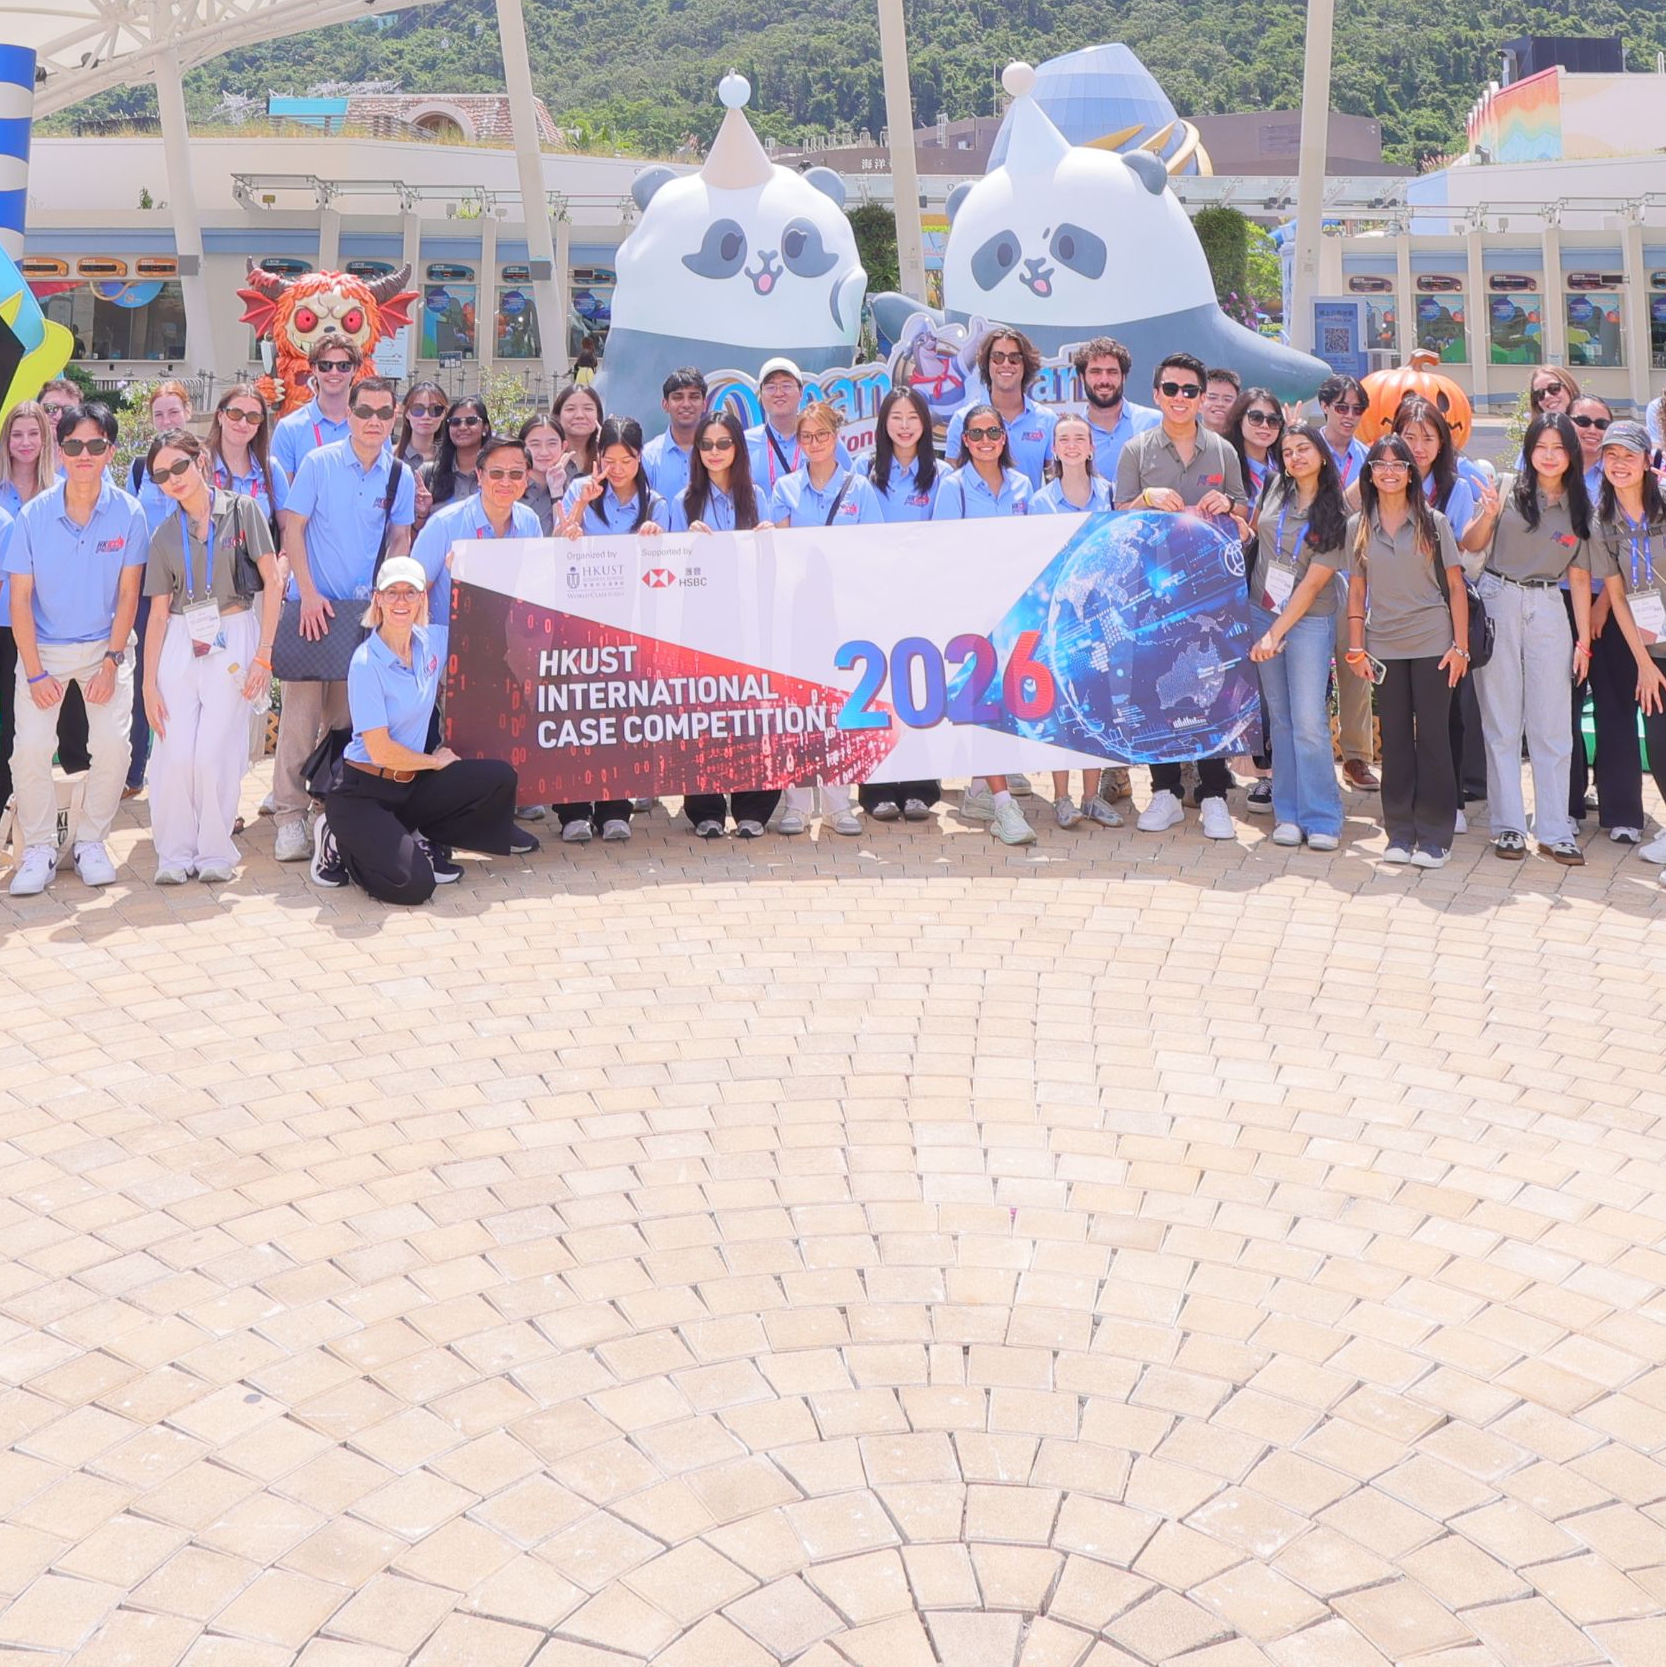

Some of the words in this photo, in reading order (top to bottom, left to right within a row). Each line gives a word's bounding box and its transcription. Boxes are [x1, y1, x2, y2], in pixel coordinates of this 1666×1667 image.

[567, 551, 606, 561] Organized
[607, 551, 617, 560] by
[641, 547, 681, 557] Supported
[683, 547, 693, 556] by
[582, 564, 625, 576] HKUST
[679, 577, 708, 587] HSBC
[538, 645, 637, 677] HKUST
[833, 631, 1056, 732] 2026
[538, 673, 780, 713] INTERNATIONAL
[537, 717, 618, 749] CASE
[623, 705, 827, 744] COMPETITION
